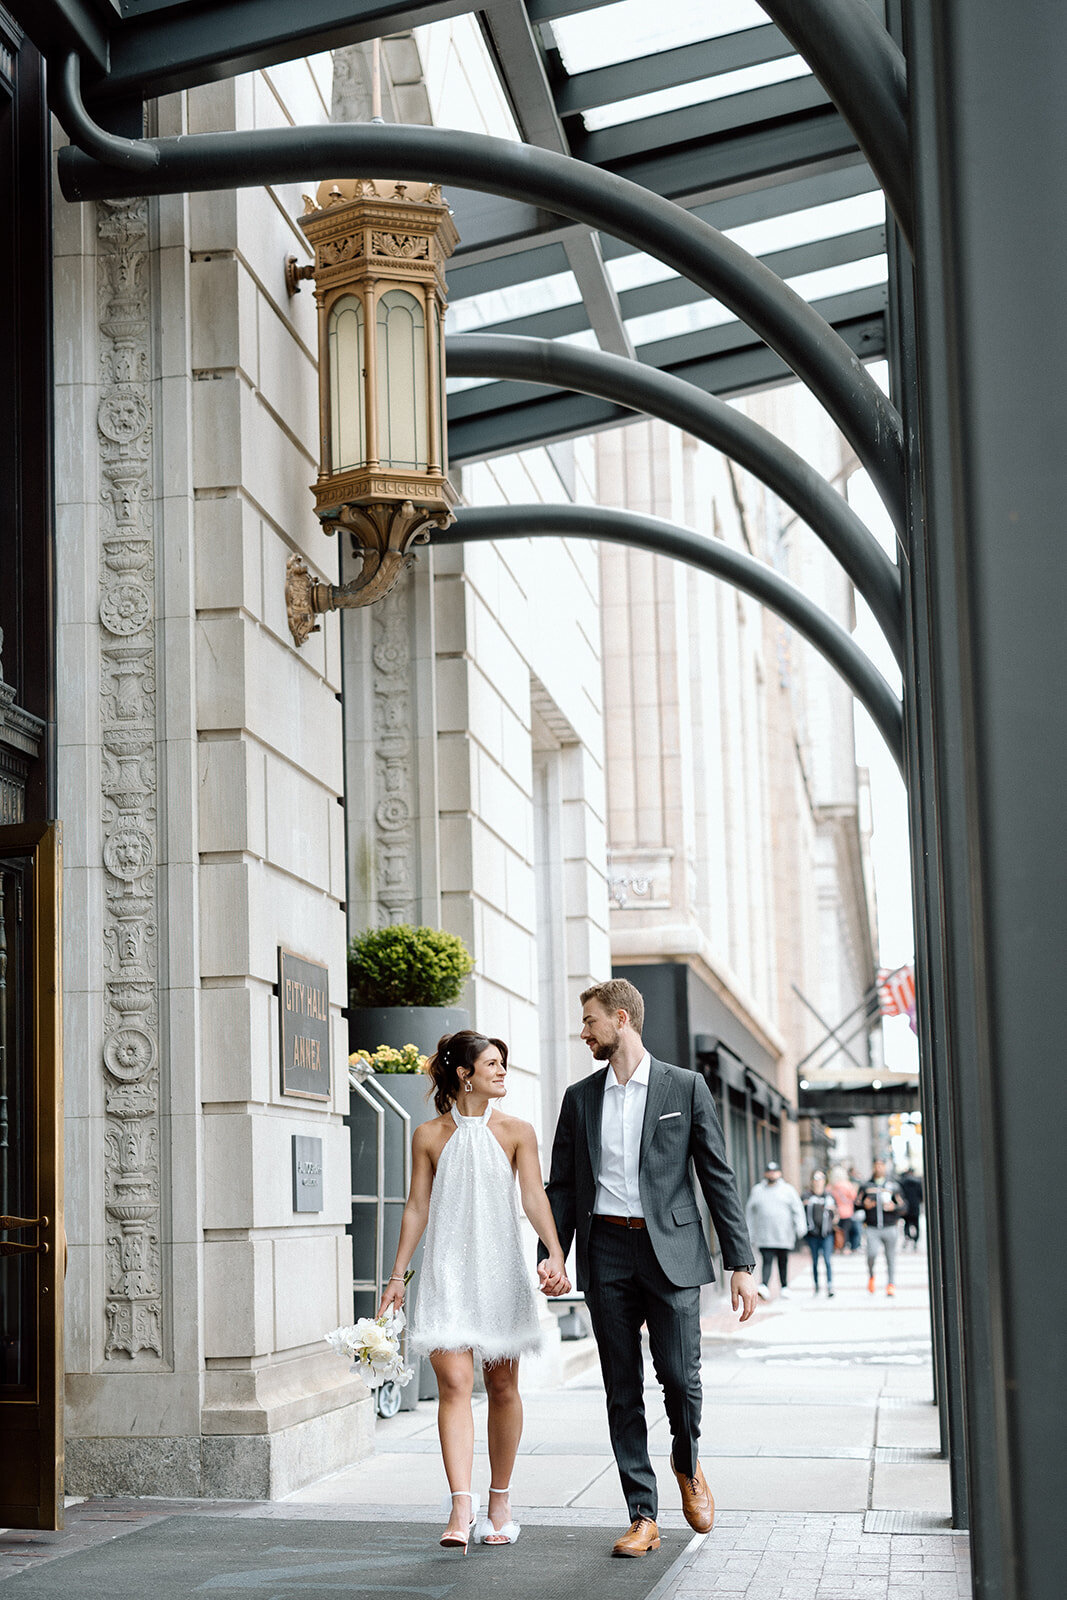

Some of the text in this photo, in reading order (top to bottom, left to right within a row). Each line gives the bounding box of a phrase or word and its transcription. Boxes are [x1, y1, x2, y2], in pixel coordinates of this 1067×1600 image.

[285, 979, 327, 1022] CITY HALL
[294, 1034, 321, 1072] ANNEX
